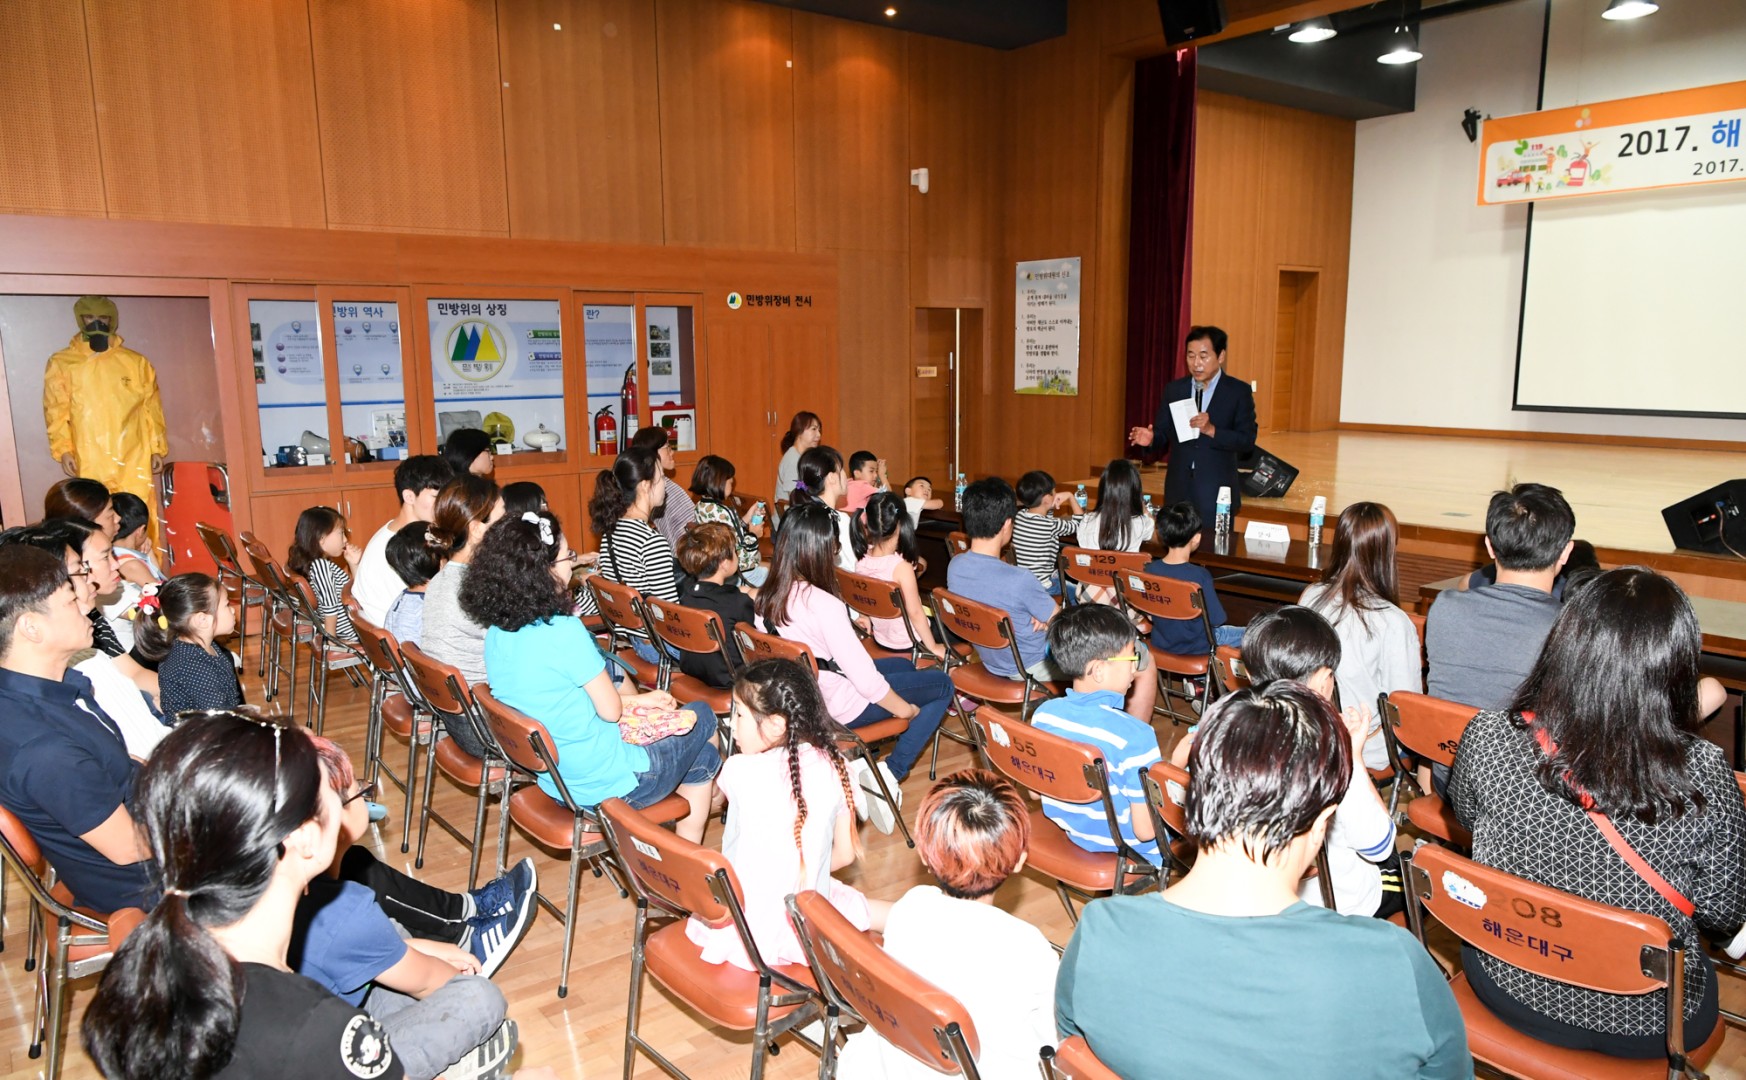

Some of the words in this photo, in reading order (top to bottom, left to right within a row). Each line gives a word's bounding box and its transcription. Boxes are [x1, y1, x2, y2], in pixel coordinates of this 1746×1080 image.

[1618, 125, 1698, 158] 2017.
[1711, 118, 1741, 148] 해
[1692, 158, 1744, 176] 2017.
[746, 294, 791, 307] 민방위장비
[795, 295, 812, 307] 전시
[362, 306, 384, 318] 역사
[437, 303, 481, 316] 민방위의
[486, 303, 507, 316] 상징
[586, 309, 600, 320] 란?
[1093, 555, 1117, 565] 129
[1088, 568, 1119, 577] 해운대
[1144, 580, 1161, 592] 93
[666, 610, 681, 623] 54
[1013, 736, 1037, 757] 55
[1010, 755, 1056, 783] 해운대구
[1481, 917, 1575, 963] 해운대구
